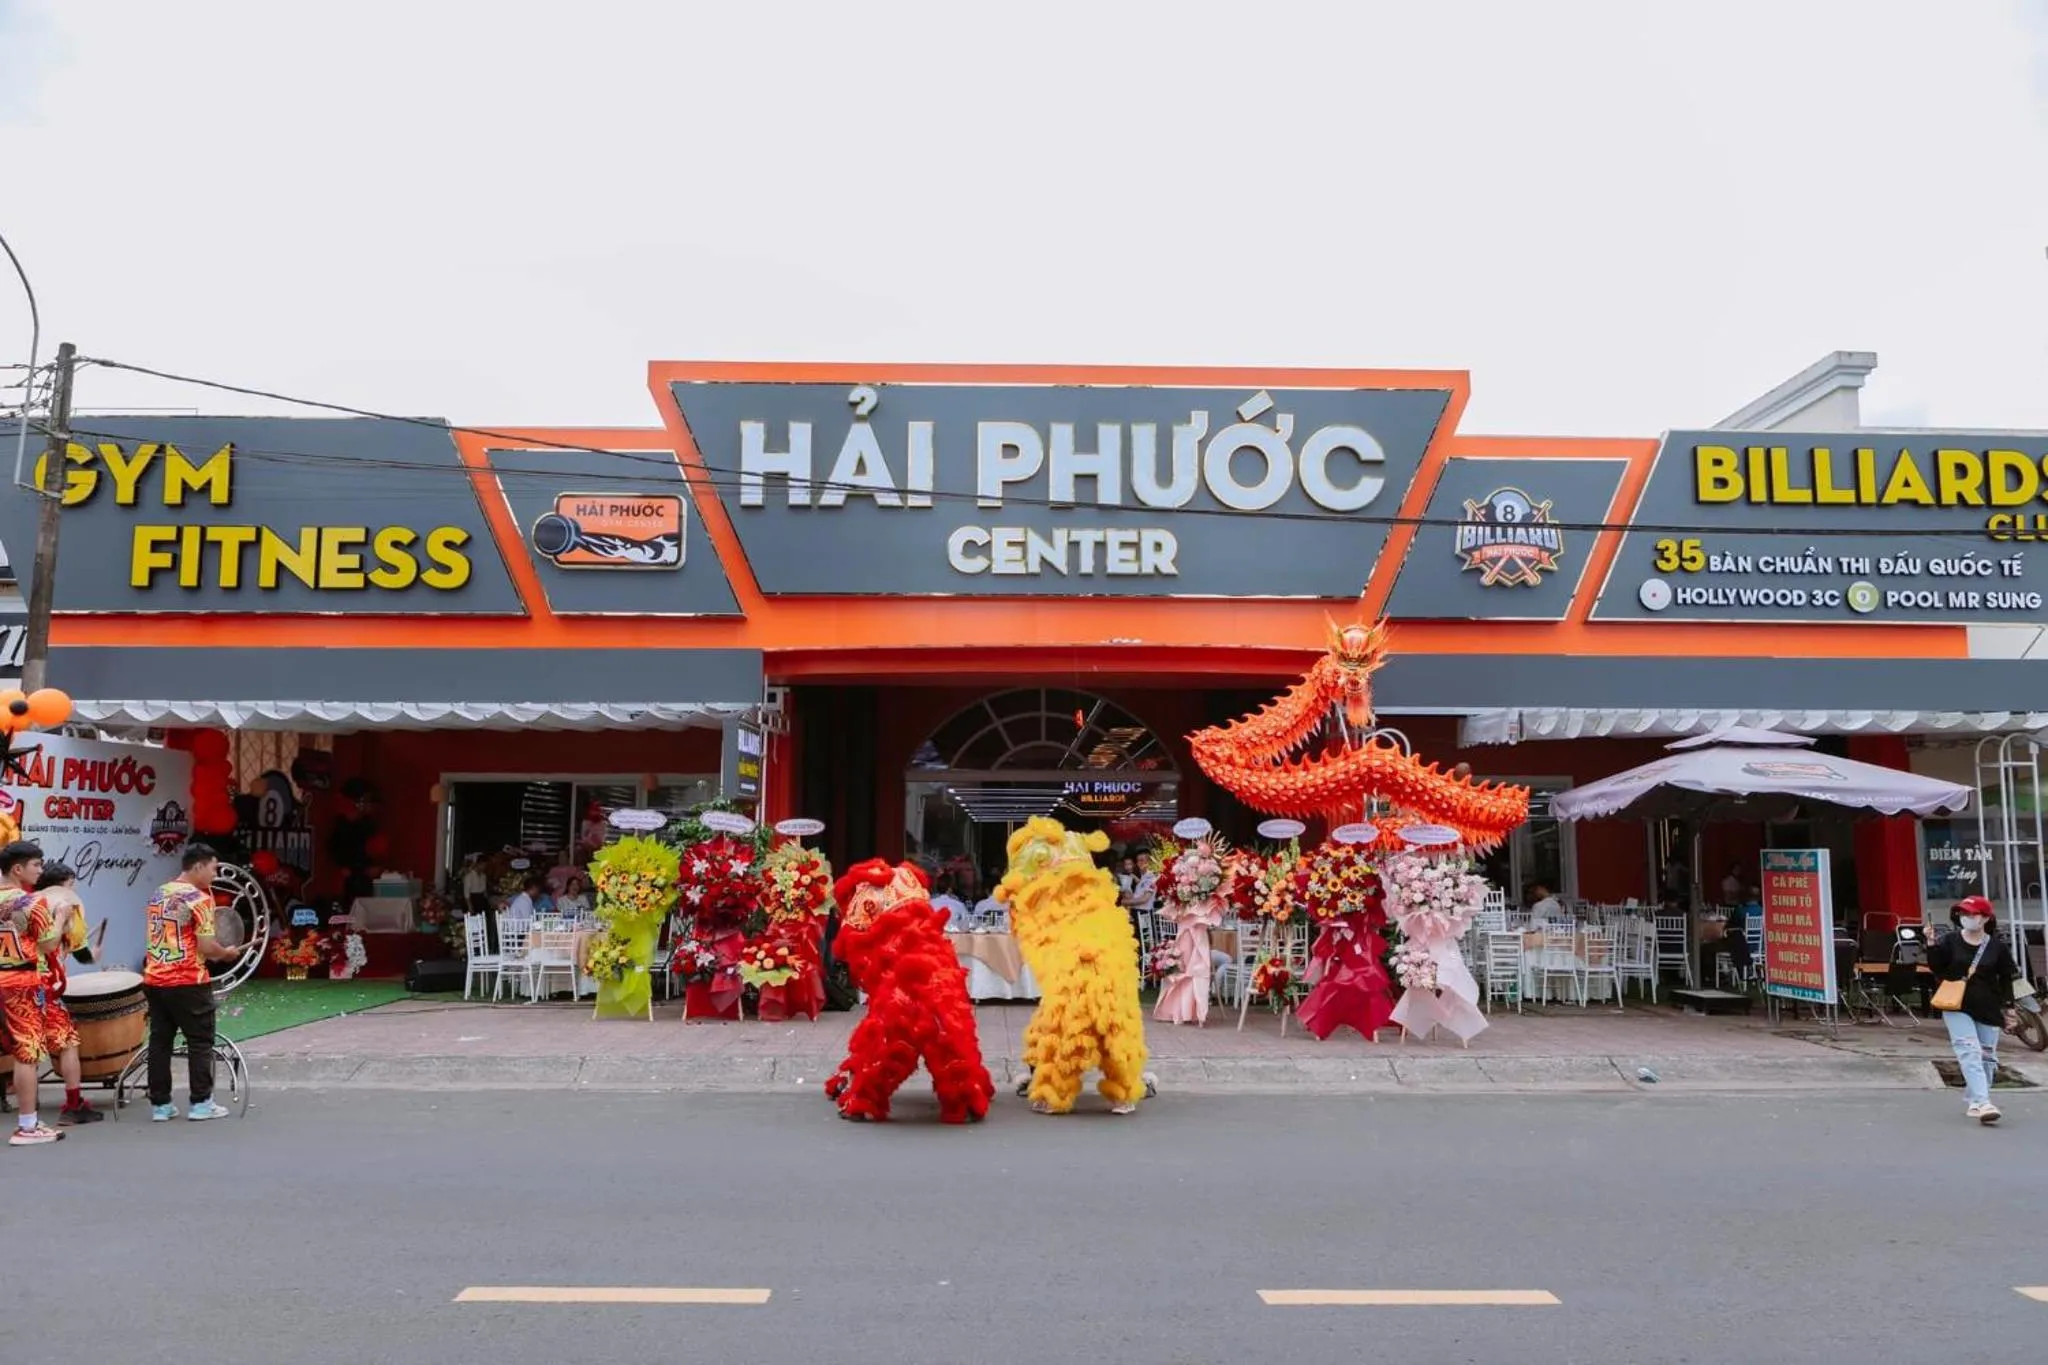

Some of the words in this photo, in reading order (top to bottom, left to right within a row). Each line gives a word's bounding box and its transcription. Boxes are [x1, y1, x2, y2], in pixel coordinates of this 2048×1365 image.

[740, 386, 934, 509] HẢI
[976, 390, 1387, 513] PHƯỚC
[34, 442, 231, 506] GYM
[1694, 445, 2048, 508] BILLIARD
[609, 500, 665, 517] PHƯỚC
[1462, 524, 1560, 550] BILLIARD
[130, 524, 472, 591] FITNESS
[947, 525, 1180, 576] CENTER
[1655, 538, 1706, 573] 35
[1709, 551, 1752, 573] BÀN
[1758, 546, 1833, 574] CHUẨN
[1840, 557, 1870, 575] THI
[1878, 550, 1921, 576] ĐẤU
[1928, 551, 1993, 577] QUỐC
[2000, 552, 2025, 577] TẾ
[1676, 587, 1806, 606] HOLLYWOOD
[1811, 589, 1840, 607] 3C
[1886, 590, 1943, 608] POOL
[1949, 591, 1980, 609] MR
[1985, 592, 2042, 610] SUNG
[62, 755, 156, 796] PHƯỚC
[44, 796, 115, 821] CENTER
[75, 840, 147, 887] Opening
[1929, 840, 1961, 861] ĐIỂM
[1947, 865, 1977, 884] Sáng
[1772, 894, 1797, 908] SINH
[1790, 932, 1820, 947] XANH
